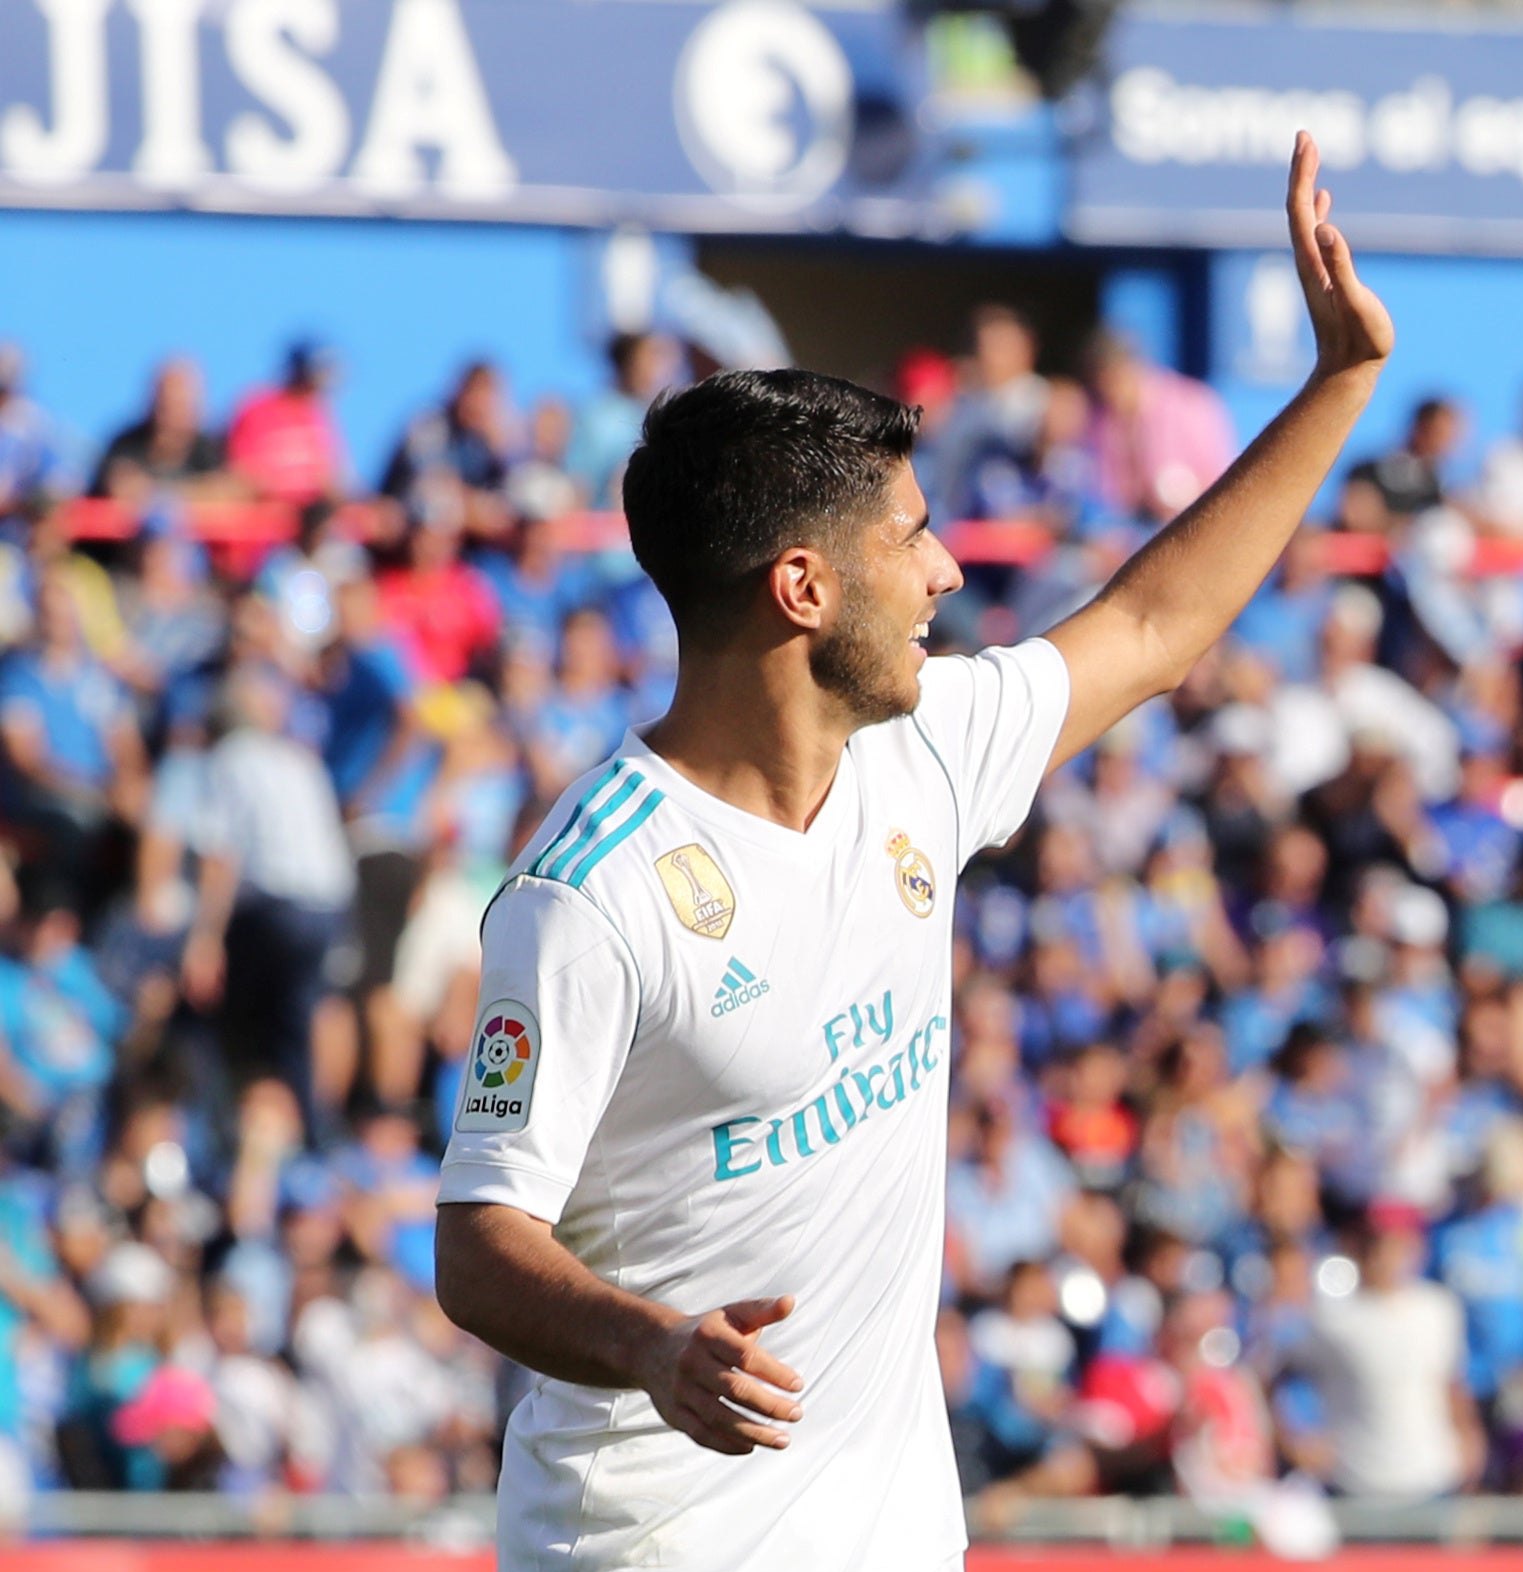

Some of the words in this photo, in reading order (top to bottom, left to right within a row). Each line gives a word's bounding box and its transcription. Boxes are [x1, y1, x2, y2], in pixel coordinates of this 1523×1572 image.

[711, 979, 771, 1018] adidas
[822, 989, 893, 1063] Fly
[466, 1094, 522, 1118] LaLiga
